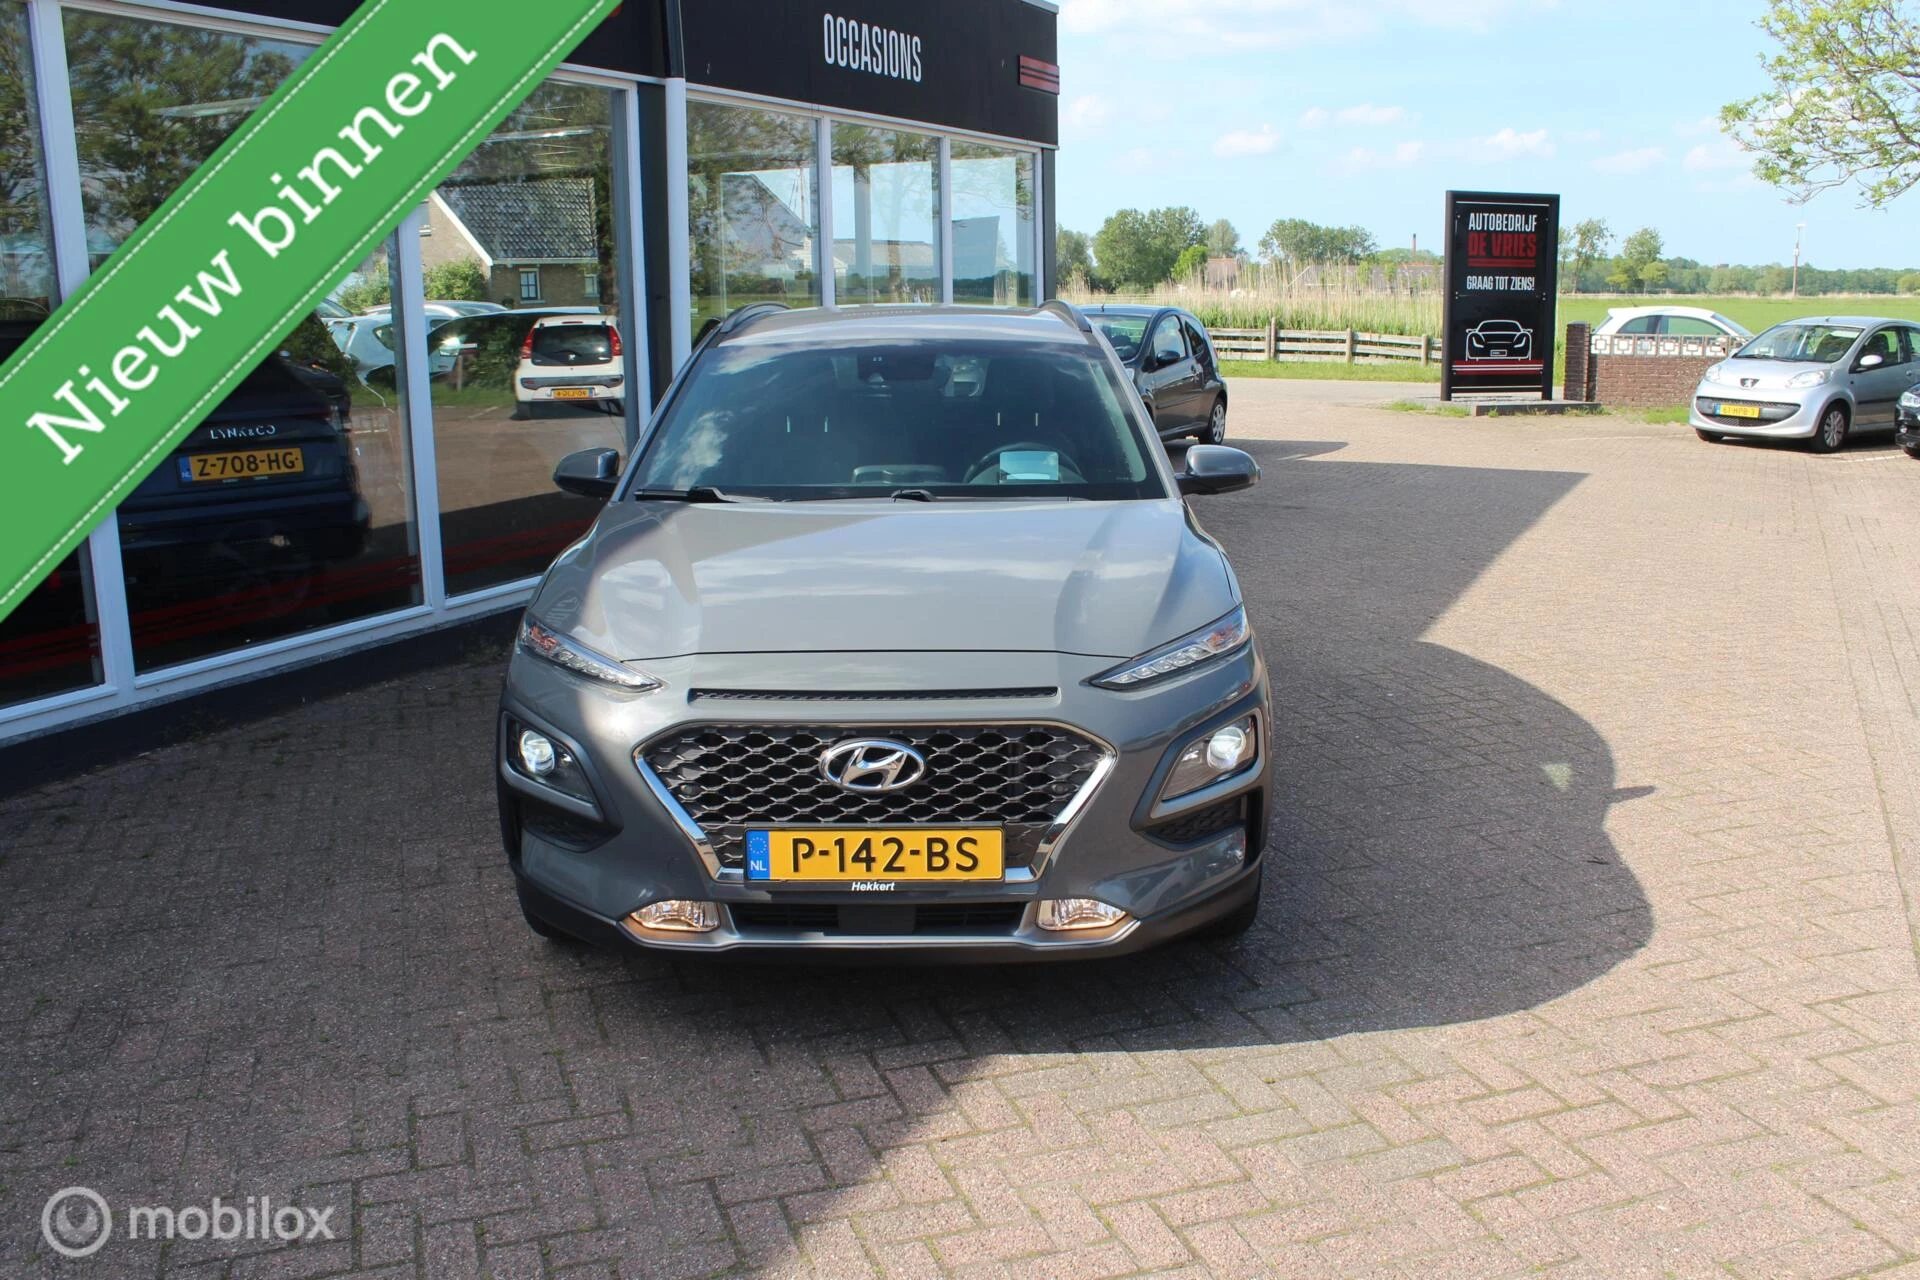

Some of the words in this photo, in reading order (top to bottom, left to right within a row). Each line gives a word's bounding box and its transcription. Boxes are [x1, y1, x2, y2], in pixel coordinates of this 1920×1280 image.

[824, 13, 922, 82] OCCASIONS
[1468, 213, 1538, 232] AUTOBEDRIJF
[1468, 232, 1487, 256] DE
[1491, 233, 1536, 257] VRIES
[1466, 275, 1494, 290] GRAAG
[1495, 276, 1509, 290] TOT
[1510, 276, 1535, 291] ZIENS!
[197, 452, 295, 477] Z-708-HG
[750, 860, 768, 872] NL
[791, 836, 980, 873] P-142-BS
[851, 881, 896, 892] Hekkert
